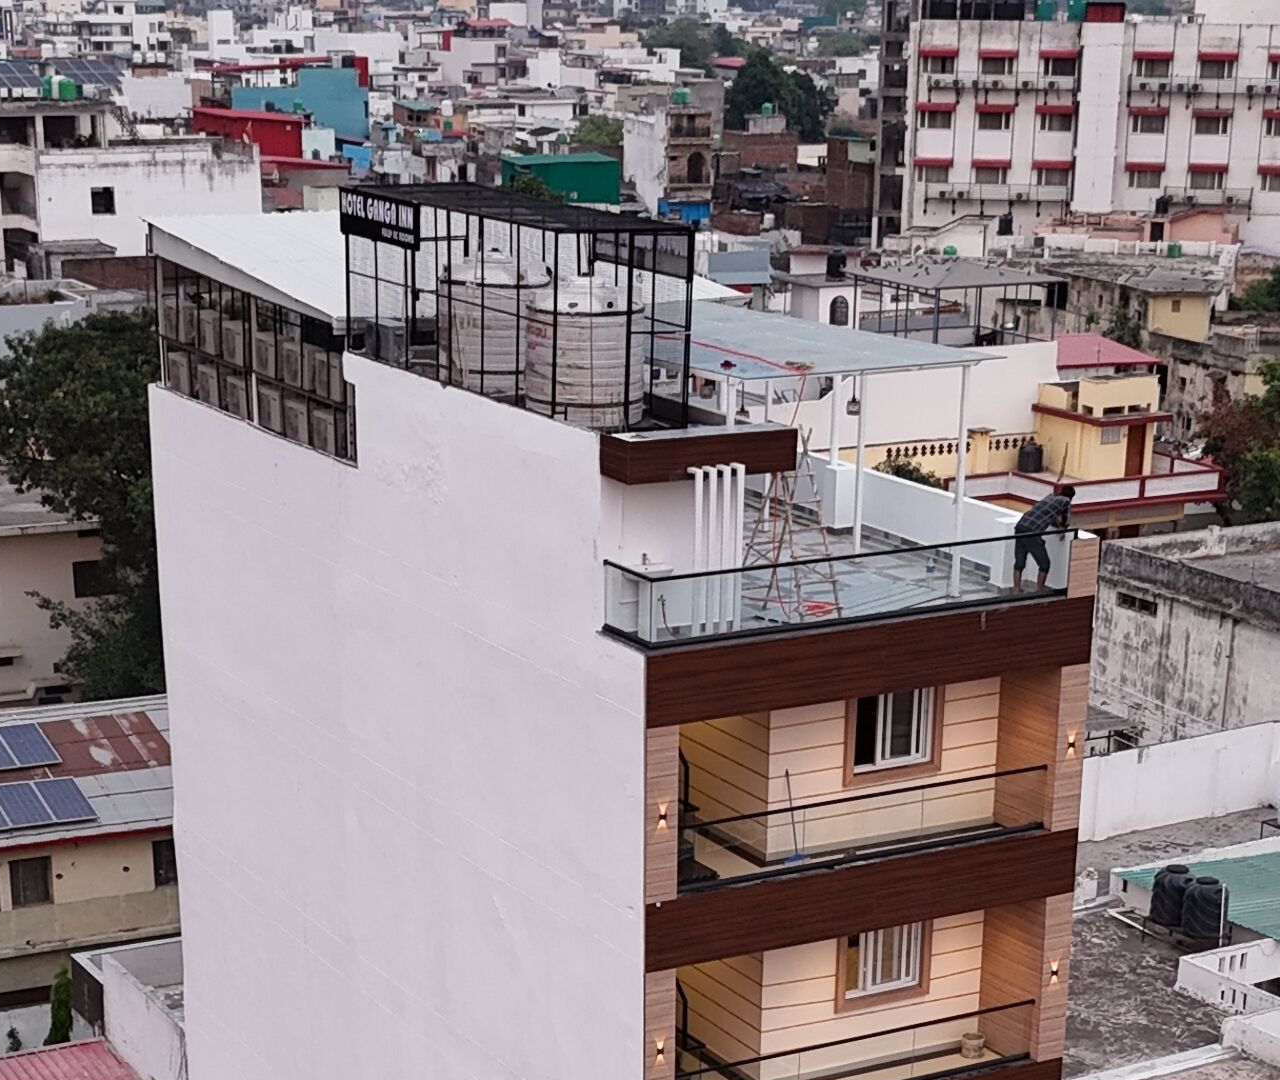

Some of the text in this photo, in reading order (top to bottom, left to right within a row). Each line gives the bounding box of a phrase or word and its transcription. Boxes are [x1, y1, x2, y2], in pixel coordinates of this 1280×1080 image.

[341, 191, 414, 230] HOTEL GANGA INN
